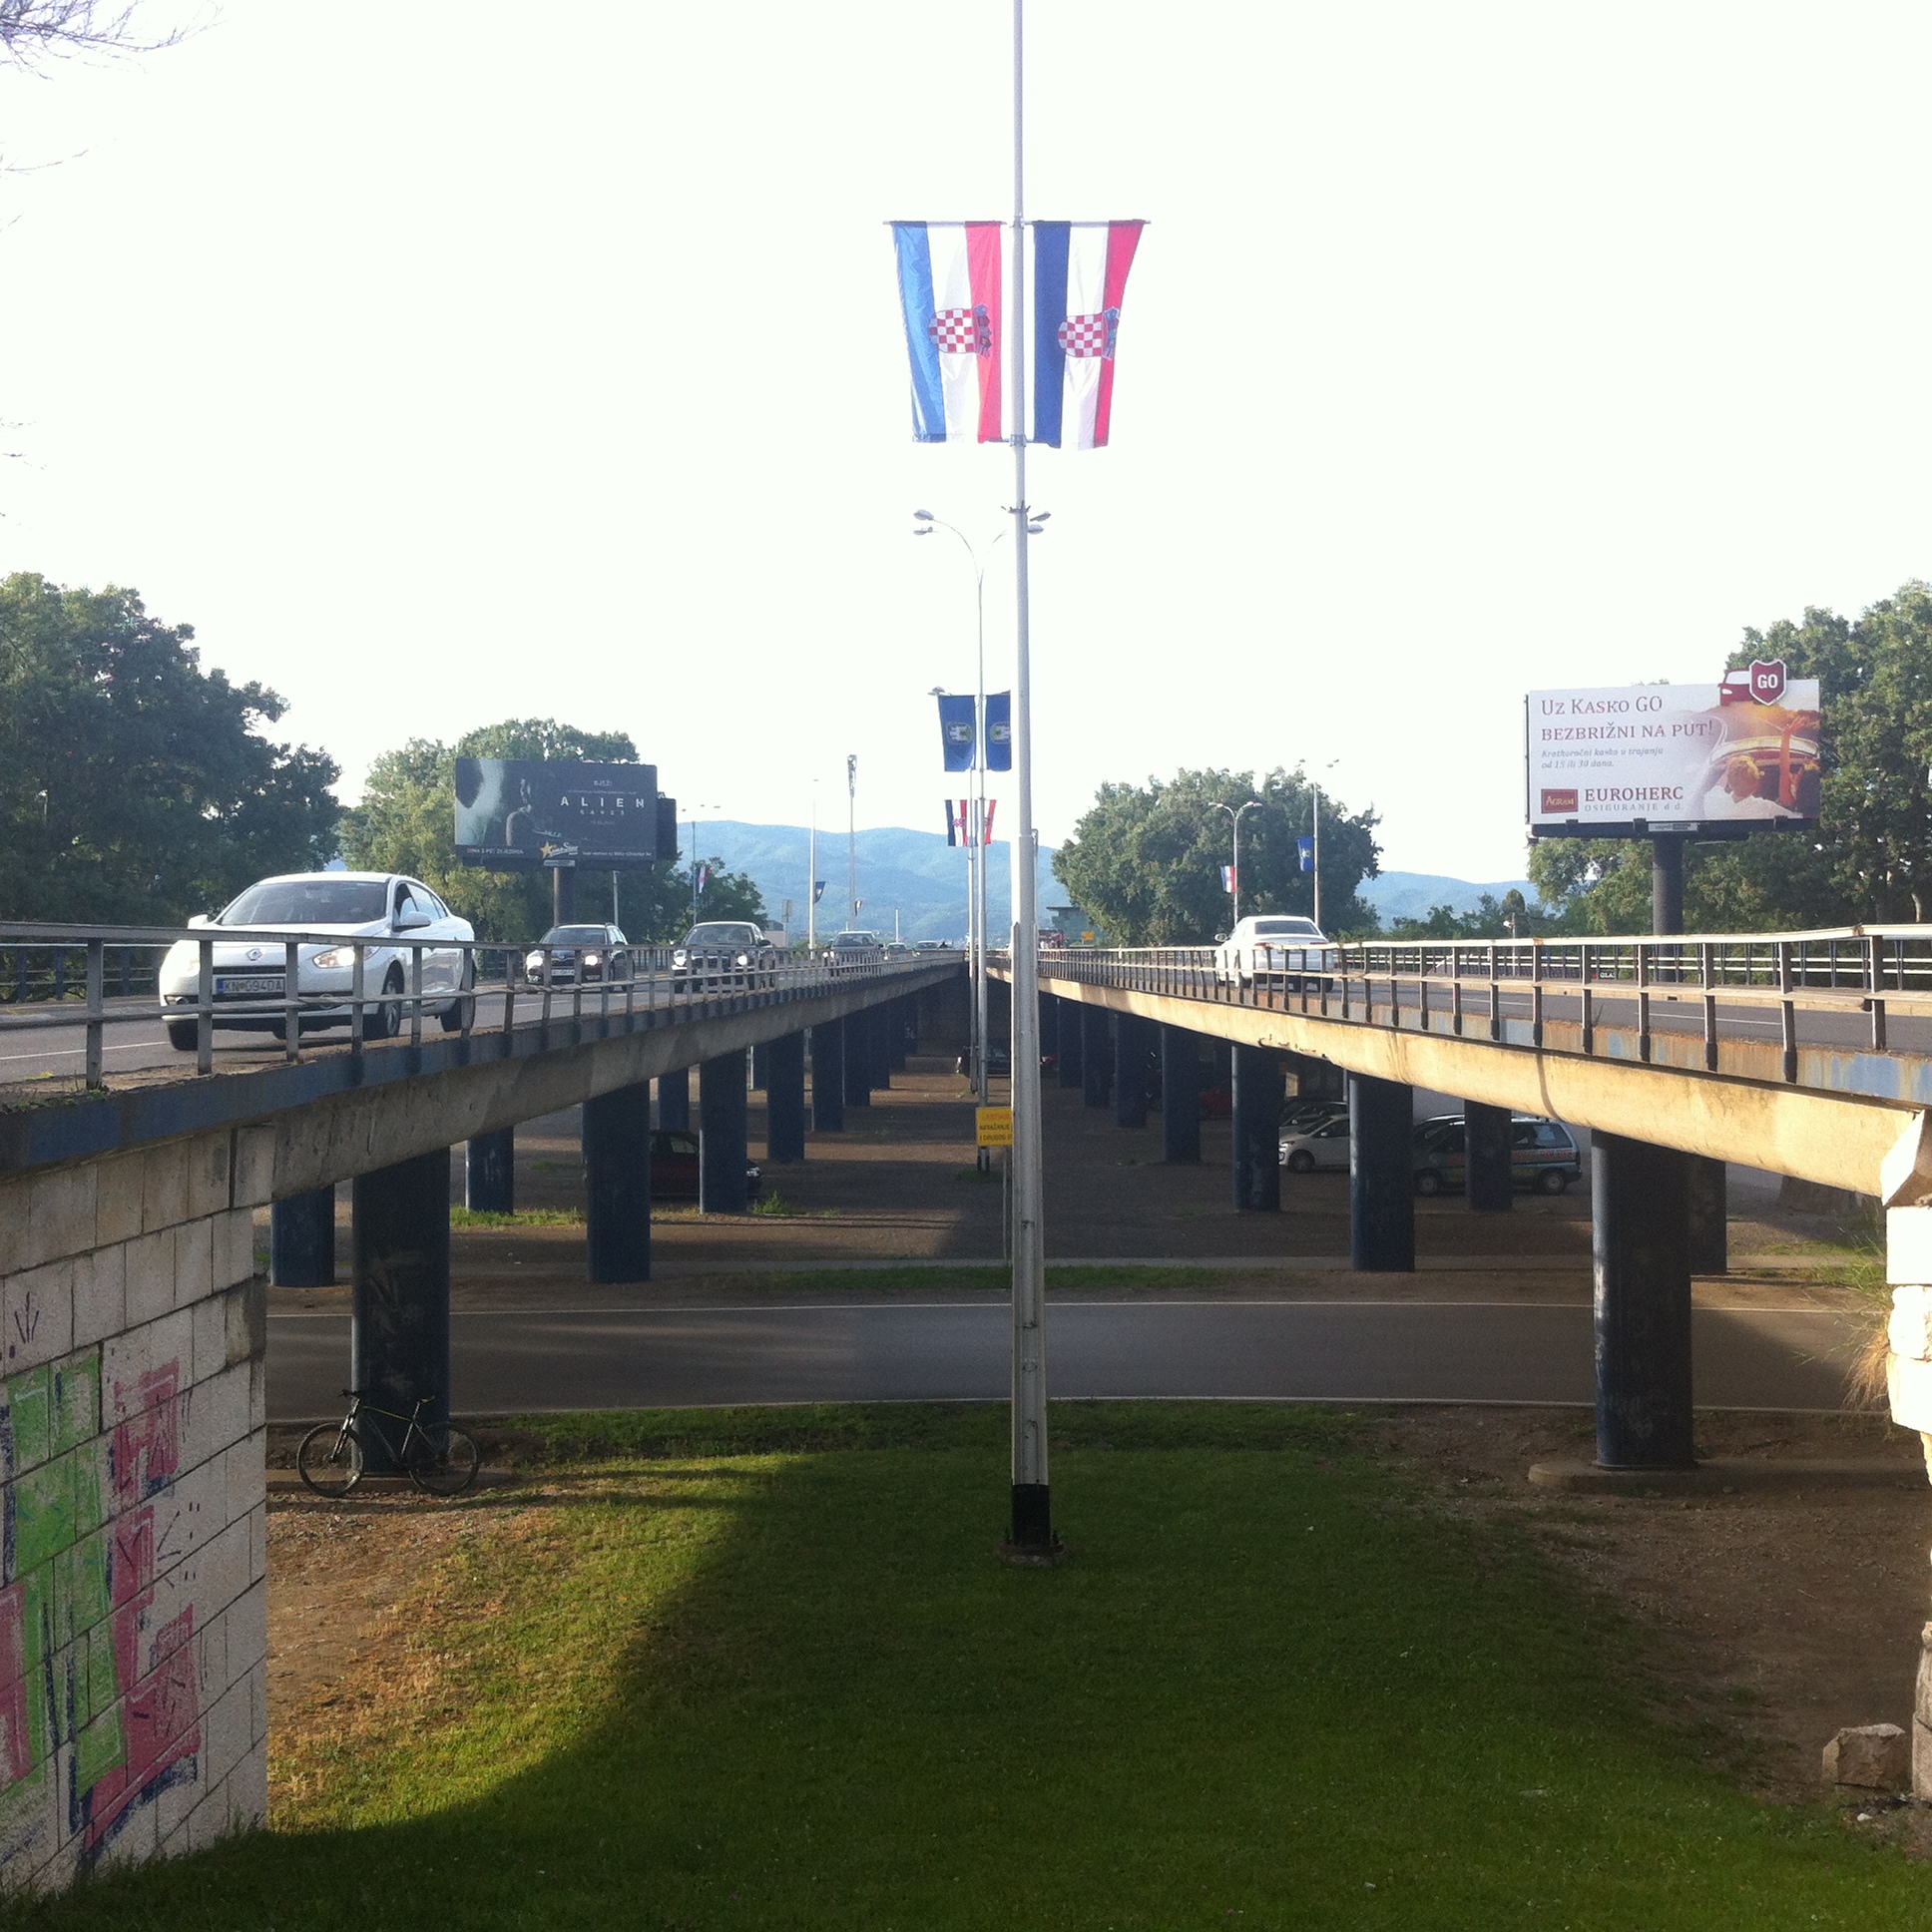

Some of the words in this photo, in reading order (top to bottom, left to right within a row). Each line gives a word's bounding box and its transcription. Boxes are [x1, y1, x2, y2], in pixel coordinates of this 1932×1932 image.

[1757, 674, 1778, 689] GO
[1636, 696, 1663, 713] GO
[1541, 722, 1636, 740] BEZBRIŽNI
[1642, 724, 1666, 738] NA
[1672, 720, 1713, 737] PUT!
[1541, 760, 1553, 769] od
[1578, 758, 1590, 767] 30
[1585, 785, 1684, 801] EUROHERC
[560, 795, 645, 808] ALIEN
[1585, 803, 1659, 812] OSIGURANJE
